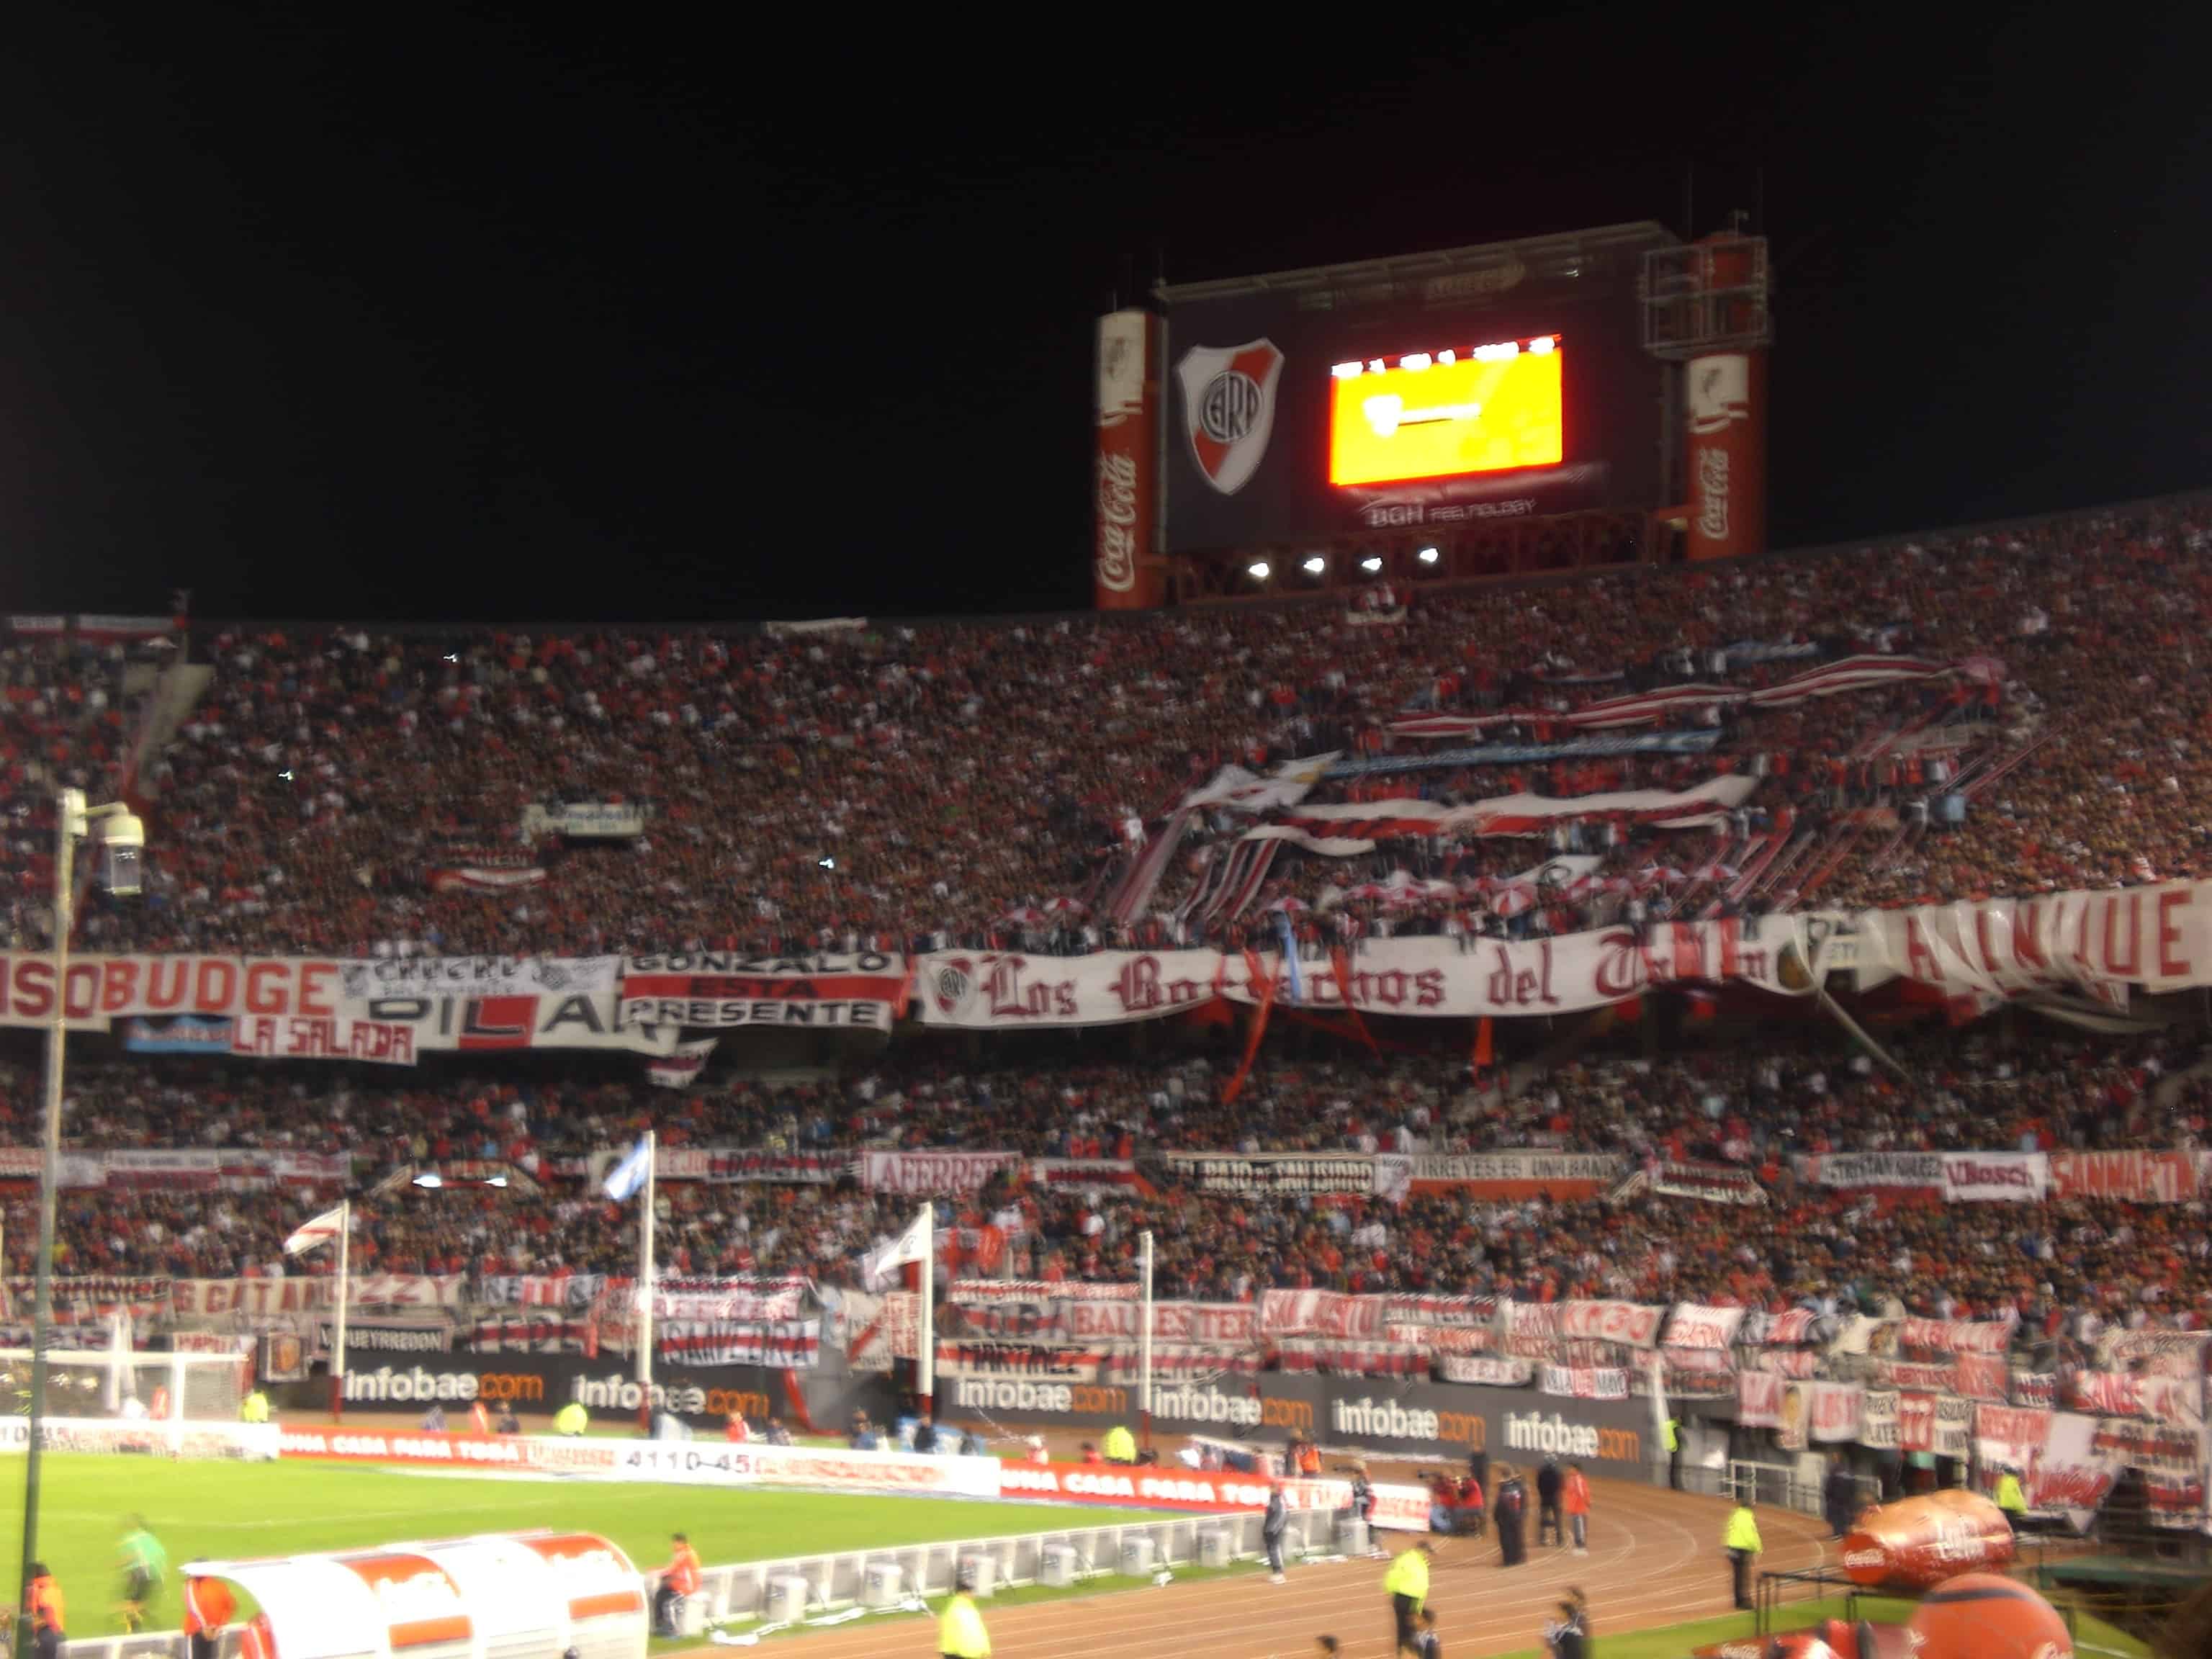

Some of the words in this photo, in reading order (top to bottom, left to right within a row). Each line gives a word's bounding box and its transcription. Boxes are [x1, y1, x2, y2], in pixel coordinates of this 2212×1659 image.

[100, 959, 338, 1016] BUDGE
[979, 955, 1079, 1015] Los
[1487, 940, 1560, 1006] del
[233, 1017, 274, 1055] LA
